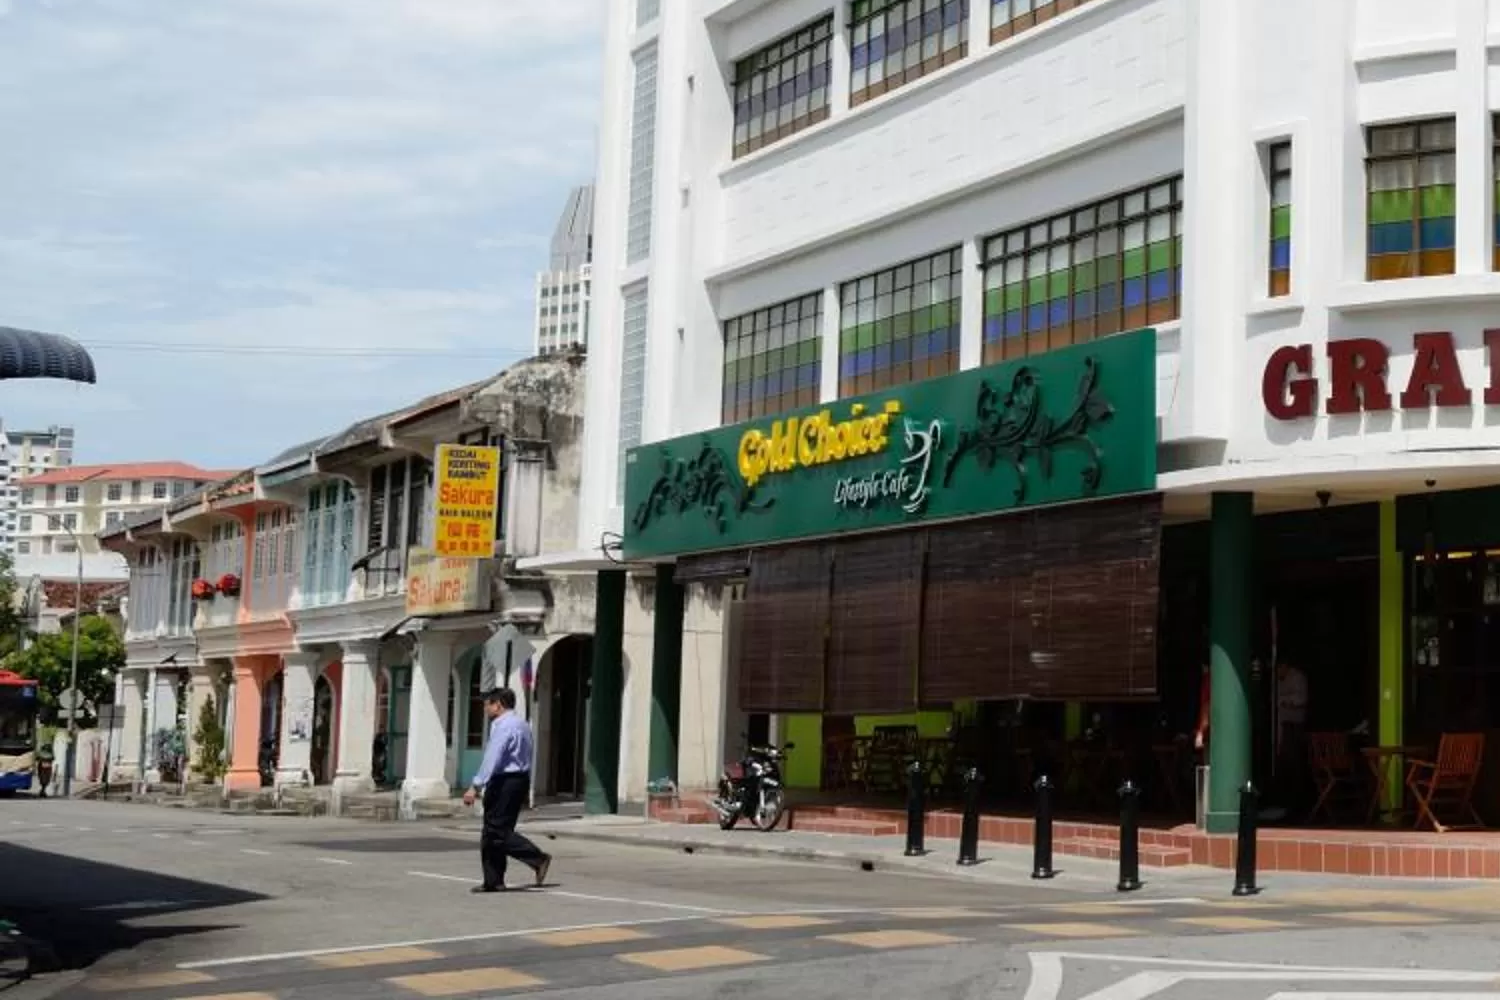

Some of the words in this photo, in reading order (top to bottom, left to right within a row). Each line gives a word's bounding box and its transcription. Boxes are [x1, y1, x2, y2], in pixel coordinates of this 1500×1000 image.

[738, 417, 799, 487] Gold
[799, 402, 889, 467] Choice
[440, 482, 495, 505] Sakura
[834, 474, 880, 508] Lifestyle
[880, 467, 910, 500] Cafe
